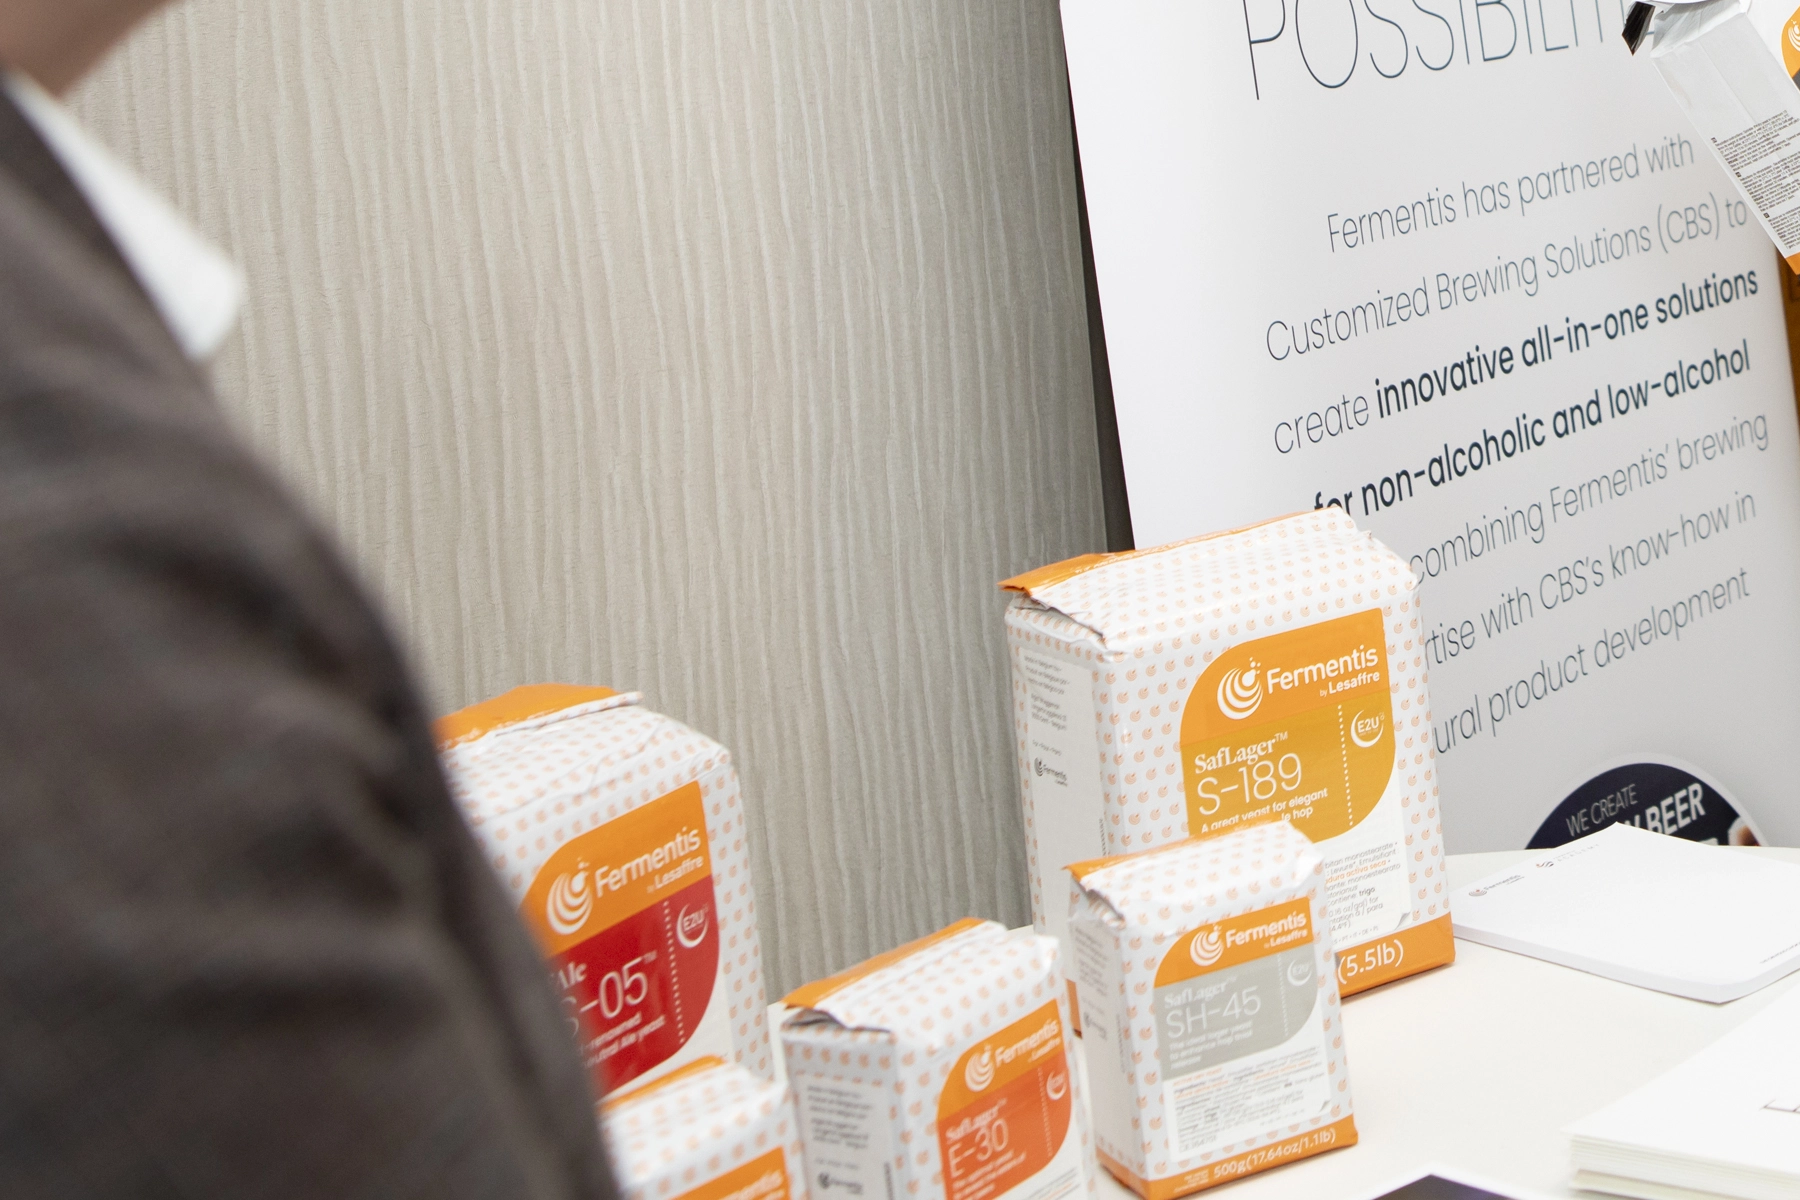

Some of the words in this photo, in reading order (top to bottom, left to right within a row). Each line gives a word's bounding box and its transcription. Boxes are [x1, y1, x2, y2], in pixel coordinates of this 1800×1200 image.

[1327, 188, 1456, 253] Fermentis
[1462, 180, 1510, 219] has
[1518, 145, 1639, 205] partnered
[1645, 134, 1695, 175] with
[1266, 280, 1429, 361] Customized
[1436, 251, 1538, 311] Brewing
[1546, 216, 1651, 279] Solutions
[1657, 192, 1720, 254] (CBS)
[1725, 196, 1748, 229] to
[1274, 392, 1369, 454] create
[1376, 344, 1514, 419] innovative
[1521, 306, 1650, 368] all-in-one
[1656, 267, 1759, 324] solutions
[1362, 413, 1546, 515] non-alcoholic
[1553, 391, 1602, 439] and
[1608, 338, 1750, 419] low-alcohol
[1410, 499, 1544, 585] combining
[1677, 410, 1769, 472] brewing
[1425, 616, 1476, 668] rtise
[1480, 589, 1532, 642] with
[1610, 503, 1735, 575] know-how
[1737, 488, 1756, 521] in
[1266, 644, 1378, 694] Fermentis
[1320, 689, 1327, 697] by
[1329, 672, 1380, 695] Lesaffre
[1434, 707, 1481, 755] ural
[1487, 652, 1586, 733] product
[1594, 567, 1750, 666] development
[1357, 716, 1379, 733] E2U
[1198, 753, 1302, 815] S-189
[1272, 800, 1287, 814] for
[1289, 788, 1328, 809] elegant
[1646, 783, 1705, 835] BEER
[1293, 806, 1313, 823] hop
[1566, 811, 1590, 837] WE
[1591, 784, 1638, 824] CREATE
[594, 826, 701, 898] Fermentis
[654, 856, 704, 889] Lesaffre
[1325, 858, 1343, 869] bitan
[1326, 873, 1344, 884] dura
[1346, 867, 1368, 879] activa
[1370, 860, 1387, 871] seca
[1359, 887, 1376, 898] trigo
[1226, 911, 1306, 948] Fermentis
[1270, 929, 1308, 947] Lesaffre
[1338, 939, 1403, 984] (5.5lb)
[1166, 986, 1261, 1039] SH-45
[995, 1019, 1059, 1067] Fermentis
[948, 1119, 1009, 1178] E-30
